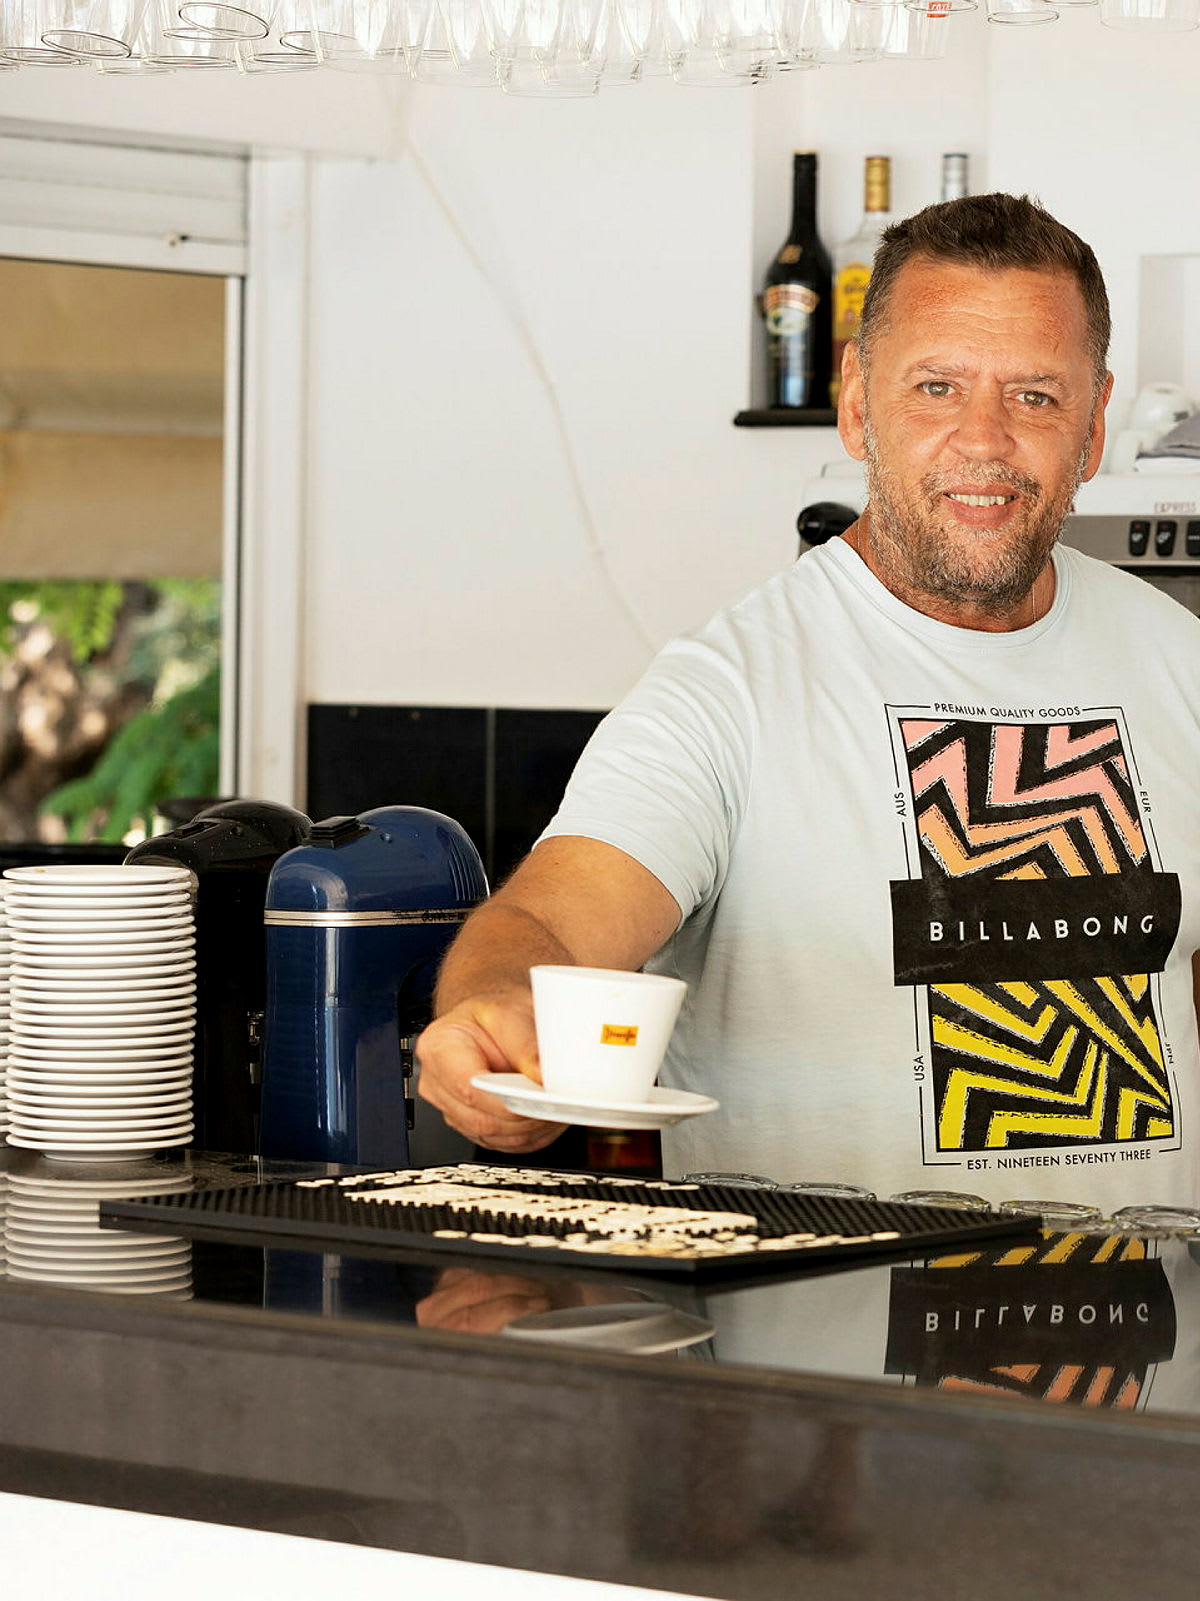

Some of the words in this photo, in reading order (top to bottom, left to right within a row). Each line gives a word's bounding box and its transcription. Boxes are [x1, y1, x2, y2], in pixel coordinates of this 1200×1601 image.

[1153, 501, 1197, 513] EXPRESS
[934, 702, 987, 716] PREMIUM
[990, 707, 1035, 719] QUALITY
[1038, 706, 1082, 718] GOODS
[893, 792, 907, 817] AUS
[1139, 790, 1152, 814] EUR
[930, 914, 1155, 942] BILLABONG
[914, 1054, 925, 1081] USA
[967, 1159, 992, 1170] EST.
[997, 1156, 1060, 1169] NINETEEN
[1065, 1152, 1116, 1165] SEVENTY
[1120, 1149, 1151, 1161] THREE
